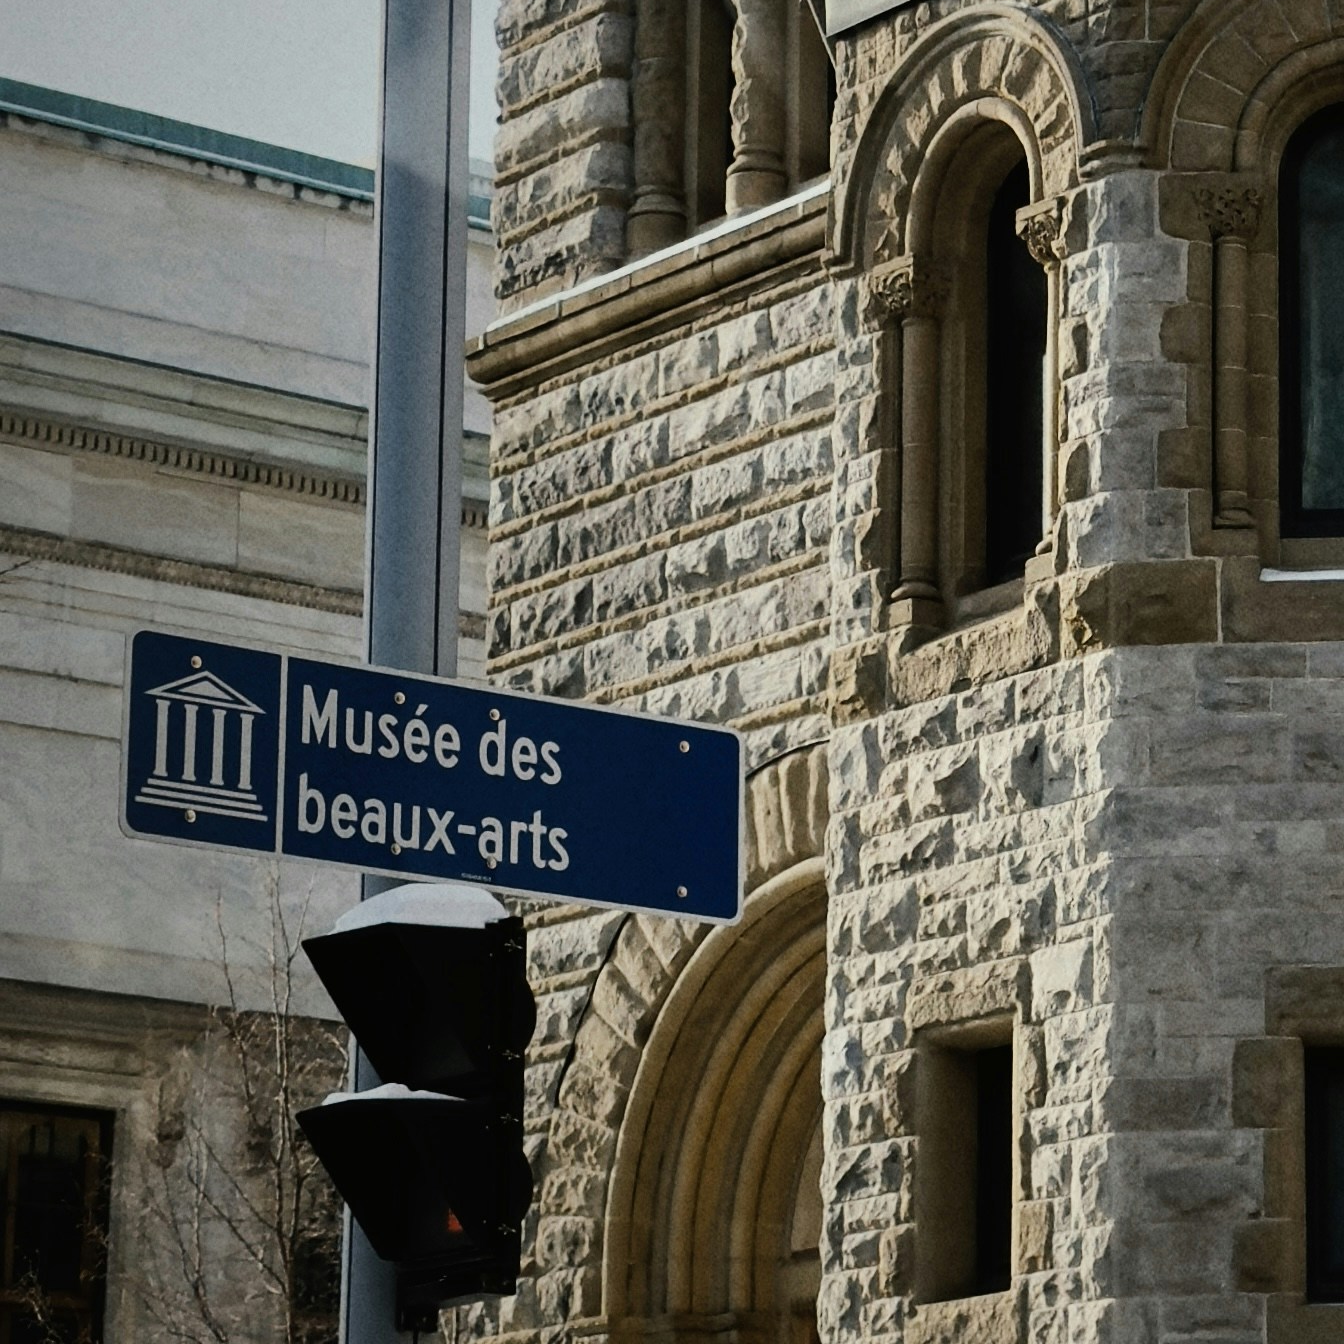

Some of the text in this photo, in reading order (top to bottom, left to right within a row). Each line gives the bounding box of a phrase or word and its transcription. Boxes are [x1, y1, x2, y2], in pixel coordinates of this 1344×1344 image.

[301, 684, 562, 785] Musée des
[298, 772, 570, 872] beaux-arts
